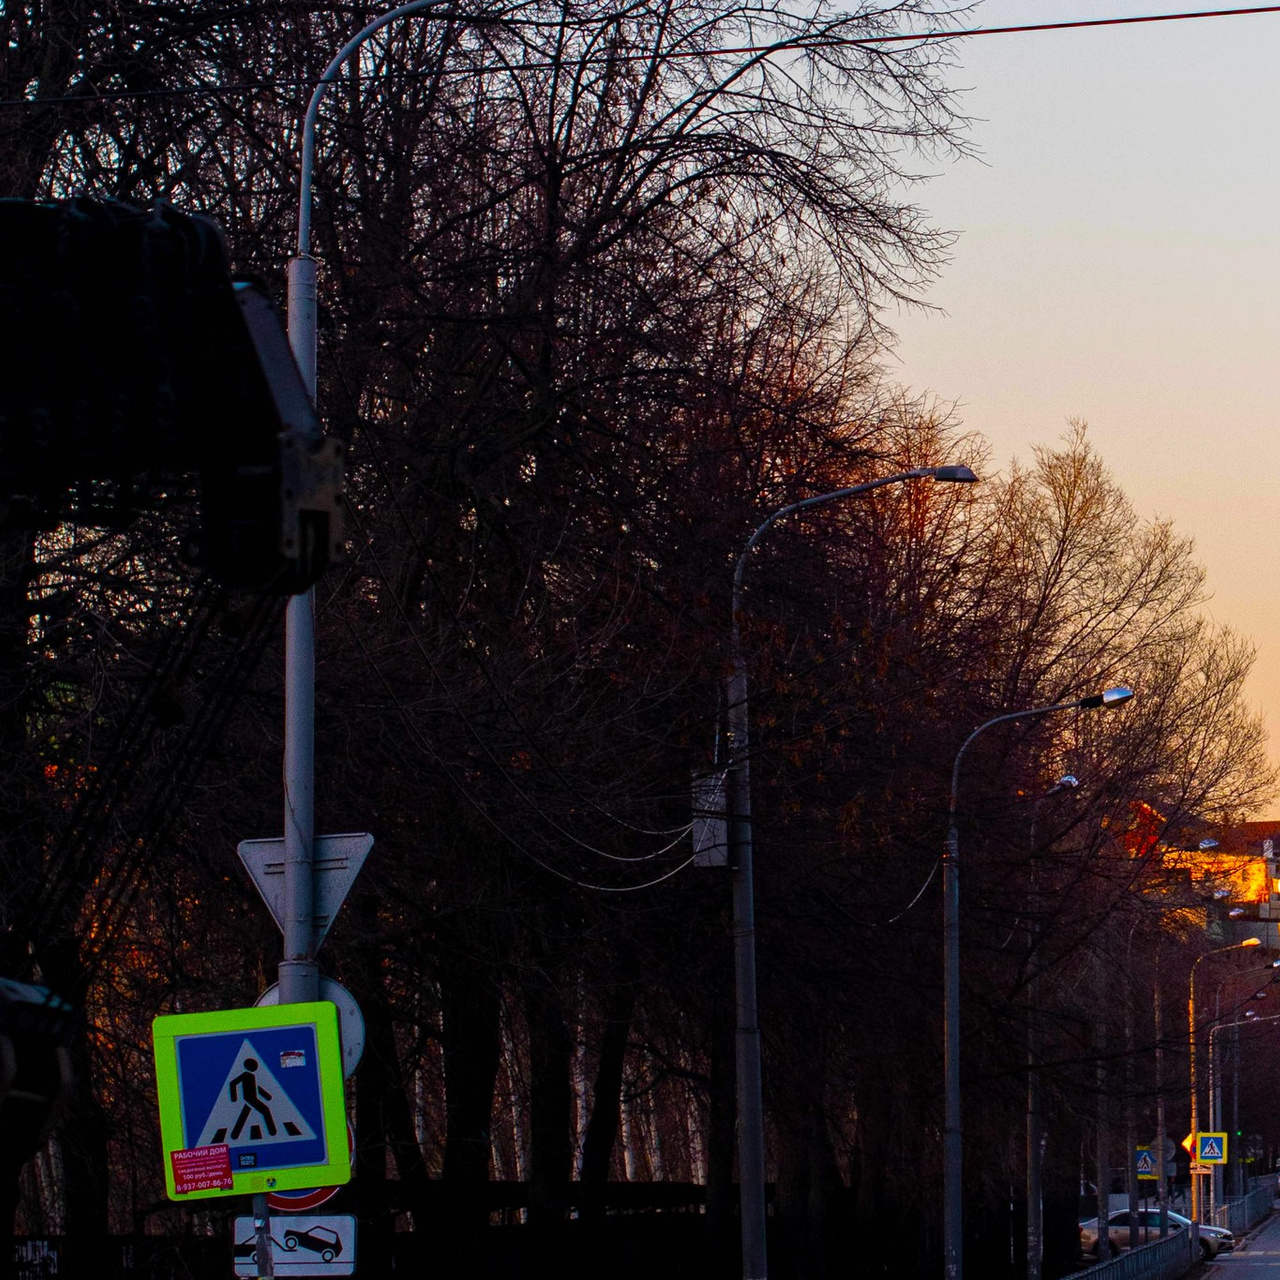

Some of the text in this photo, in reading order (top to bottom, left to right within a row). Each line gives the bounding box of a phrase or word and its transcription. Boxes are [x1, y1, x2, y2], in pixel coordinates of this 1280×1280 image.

[173, 1146, 227, 1160] РАБОЧИЙ ДОМ
[176, 1177, 232, 1192] 8-937-007-86-76
